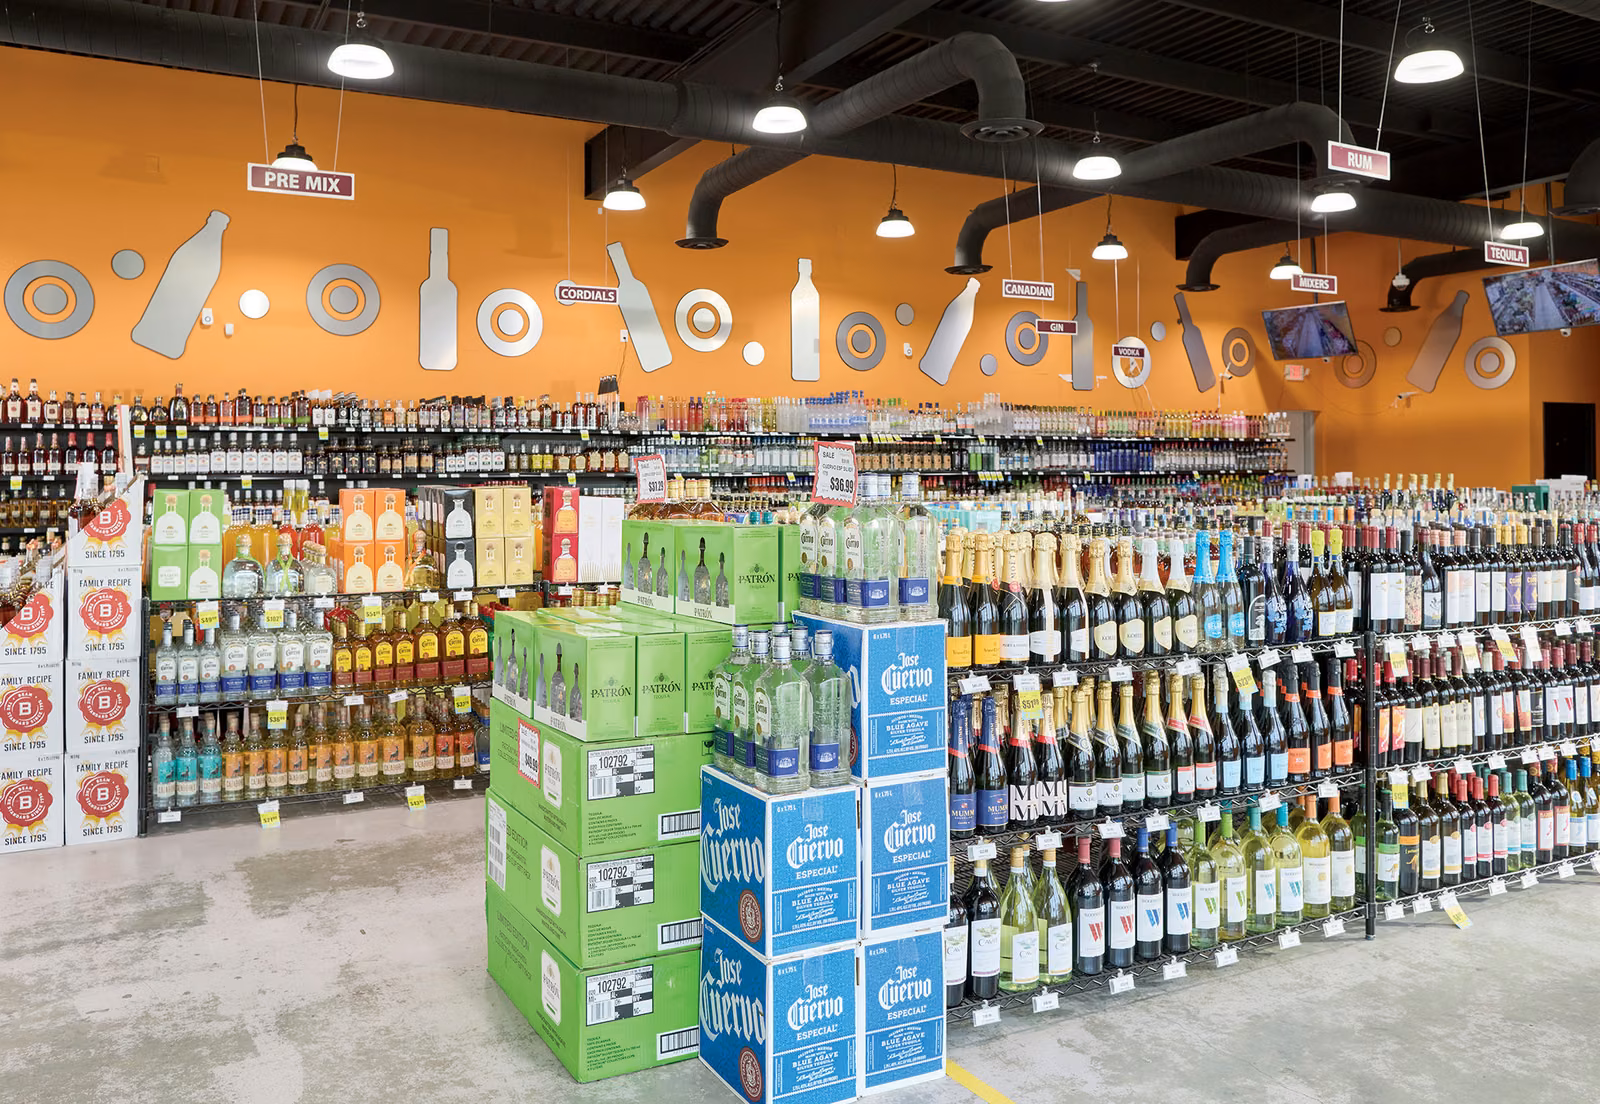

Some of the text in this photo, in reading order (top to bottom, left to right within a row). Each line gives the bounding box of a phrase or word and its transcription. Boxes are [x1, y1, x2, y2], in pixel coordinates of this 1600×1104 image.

[1348, 152, 1372, 170] RUM
[265, 171, 340, 192] PRE MIX
[1491, 247, 1524, 262] TEQUILA
[1005, 284, 1052, 296] CANADIAN
[1300, 278, 1329, 289] MIXERS
[561, 289, 614, 301] CORDIALS
[1050, 323, 1064, 331] GIN
[1118, 348, 1140, 356] VODKA
[830, 477, 853, 493] $36.99
[100, 511, 111, 524] B
[738, 572, 775, 584] PATRÓN
[20, 607, 32, 620] B
[100, 604, 111, 616] B
[694, 607, 712, 619] PATRÓN
[30, 647, 46, 655] 1795
[108, 643, 125, 651] 1795
[898, 653, 919, 670] Jose
[0, 675, 52, 686] AMILY RECIPE
[78, 670, 130, 680] FAMILY RECIPE
[882, 664, 932, 695] Cuervo
[591, 687, 631, 698] PATRÓN
[642, 683, 681, 693] PATRÓN
[99, 696, 110, 709] B
[890, 696, 926, 705] ESPECIAL
[19, 702, 32, 716] B
[108, 733, 124, 742] 1795
[4, 741, 46, 751] SINCE 1795
[76, 761, 128, 772] FAMILY RECIPE
[599, 754, 628, 769] 102792
[0, 768, 52, 780] AMILY RECIPE
[97, 788, 109, 801] B
[19, 796, 32, 810] B
[714, 798, 740, 837] Jose
[900, 809, 922, 827] Jose
[83, 825, 122, 836] SINCE 1795
[804, 824, 828, 842] Jose
[5, 834, 47, 846] SINCE 1795
[884, 822, 936, 853] Cuervo
[701, 822, 765, 892] Cuervo
[786, 836, 843, 869] Cuervo
[892, 852, 930, 864] ESPECIAL
[599, 866, 627, 880] 102792
[796, 867, 836, 879] ESPECIAL
[907, 878, 930, 886] AGAVE
[792, 893, 838, 906] BLUE AGAVE
[714, 948, 742, 988] Jose
[896, 966, 917, 983] Jose
[598, 977, 626, 993] 102792
[805, 984, 828, 1002] Jose
[878, 978, 932, 1010] Cuervo
[700, 970, 766, 1045] Cuervo
[788, 996, 843, 1030] Cuervo
[888, 1007, 925, 1020] ESPECIAL
[797, 1026, 836, 1040] ESPECIAL
[882, 1032, 925, 1047] BLUE AGAVE
[793, 1051, 838, 1068] BLUE AGAVE
